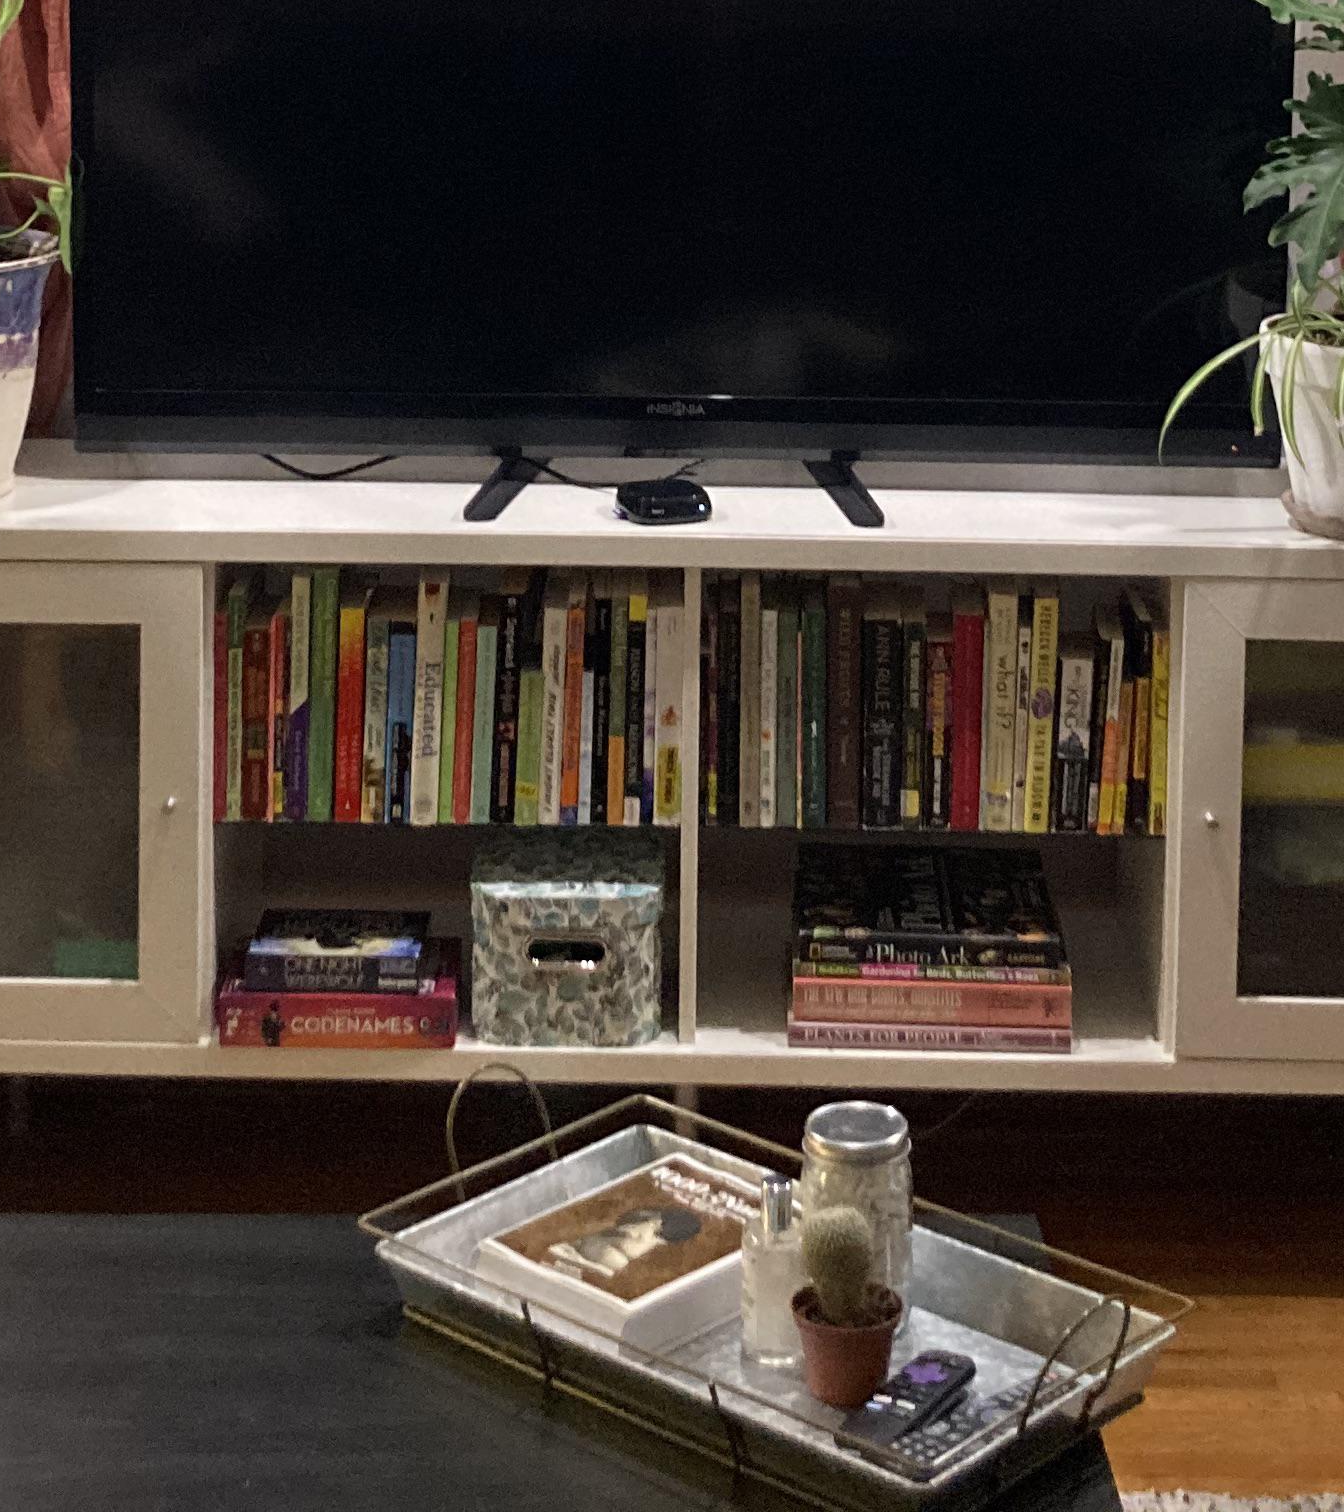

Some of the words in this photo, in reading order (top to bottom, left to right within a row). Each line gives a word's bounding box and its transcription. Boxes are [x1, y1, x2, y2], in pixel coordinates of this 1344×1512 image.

[646, 400, 706, 416] INSIGNIA
[875, 625, 890, 663] ANN
[874, 668, 890, 712] RULE
[996, 656, 1015, 698] what
[422, 663, 441, 756] Educated
[995, 706, 1013, 730] if?
[1064, 689, 1080, 730] KING
[876, 943, 931, 965] Photo
[940, 945, 969, 965] Ark
[291, 1016, 414, 1034] CODENAMES
[804, 1028, 865, 1042] PLANTS
[869, 1029, 897, 1043] FOR
